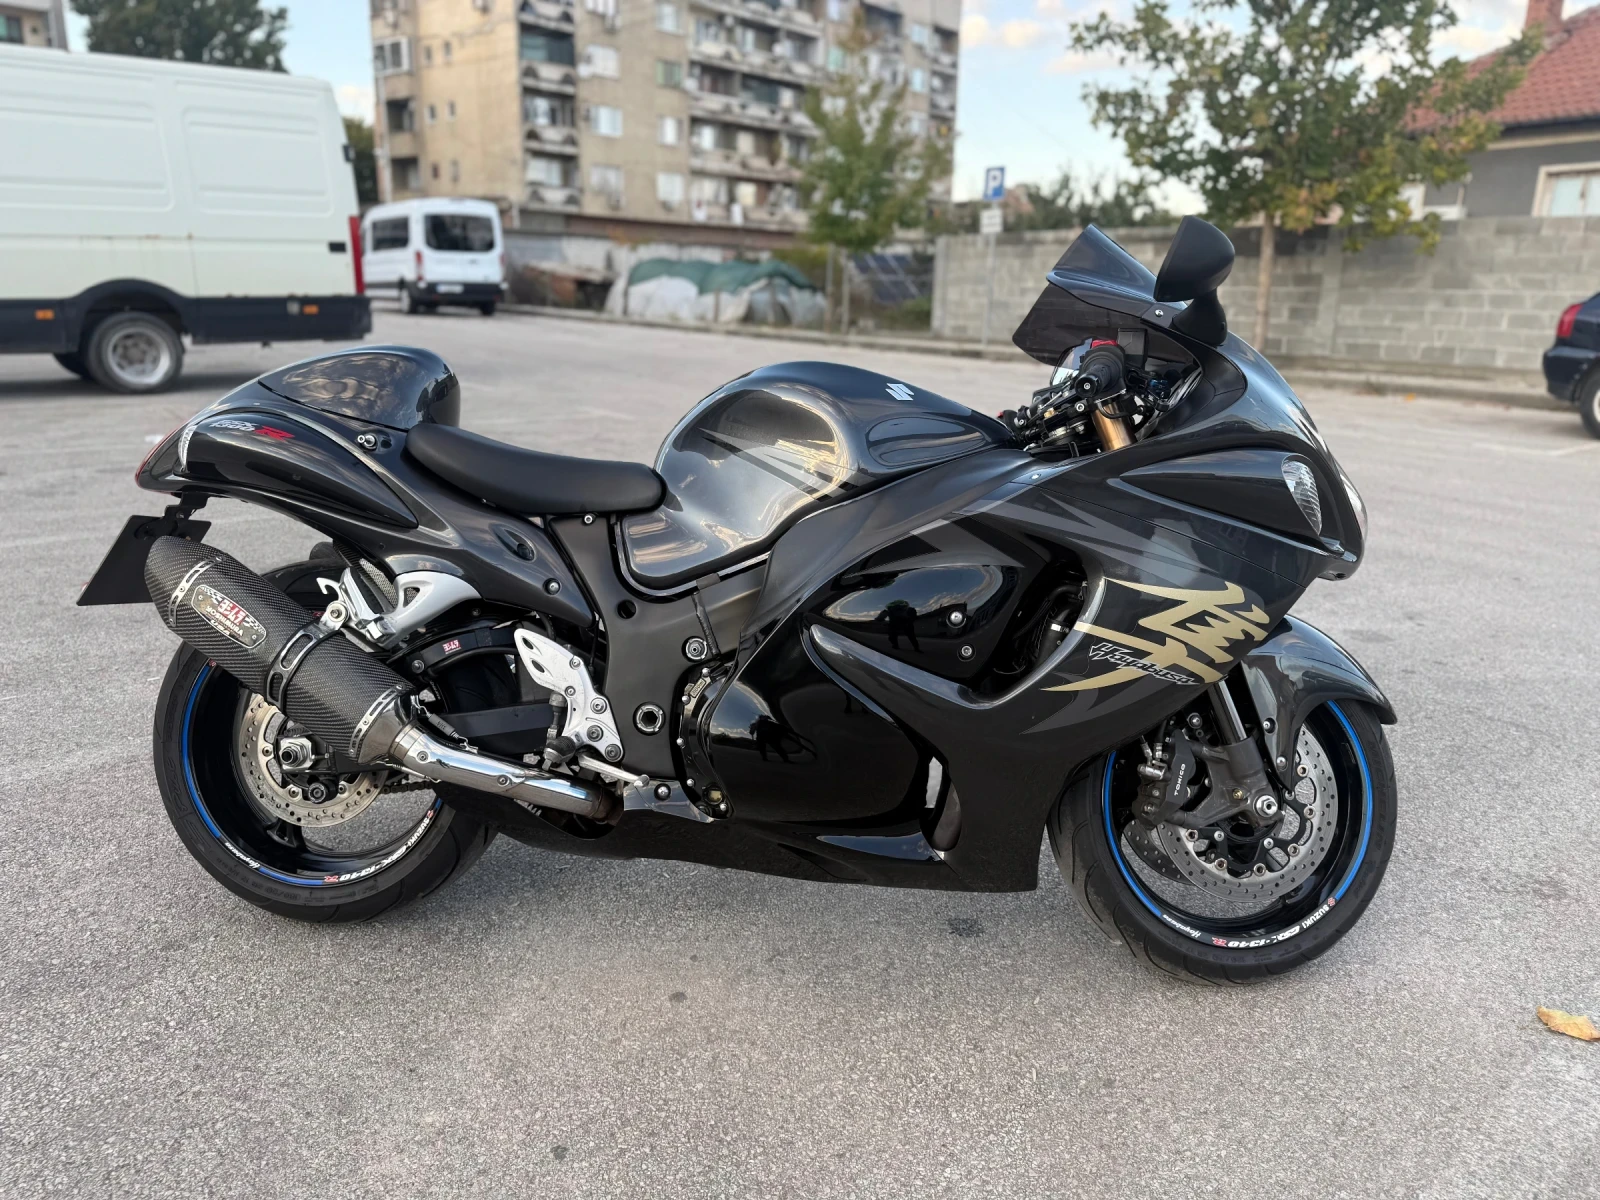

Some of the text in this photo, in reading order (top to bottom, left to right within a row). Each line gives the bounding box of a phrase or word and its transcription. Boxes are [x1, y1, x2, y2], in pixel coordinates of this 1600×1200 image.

[988, 169, 1002, 198] P
[254, 425, 295, 443] R
[205, 605, 244, 637] YOSHIMURA
[1089, 642, 1200, 686] Hayabusa
[1173, 763, 1186, 797] TOKICO
[1367, 740, 1388, 850] MICHELIN
[405, 817, 431, 847] SUZUKI
[224, 841, 261, 869] Hayabusa
[1162, 913, 1202, 939] Hayabusa
[1301, 903, 1330, 930] SUZUKI
